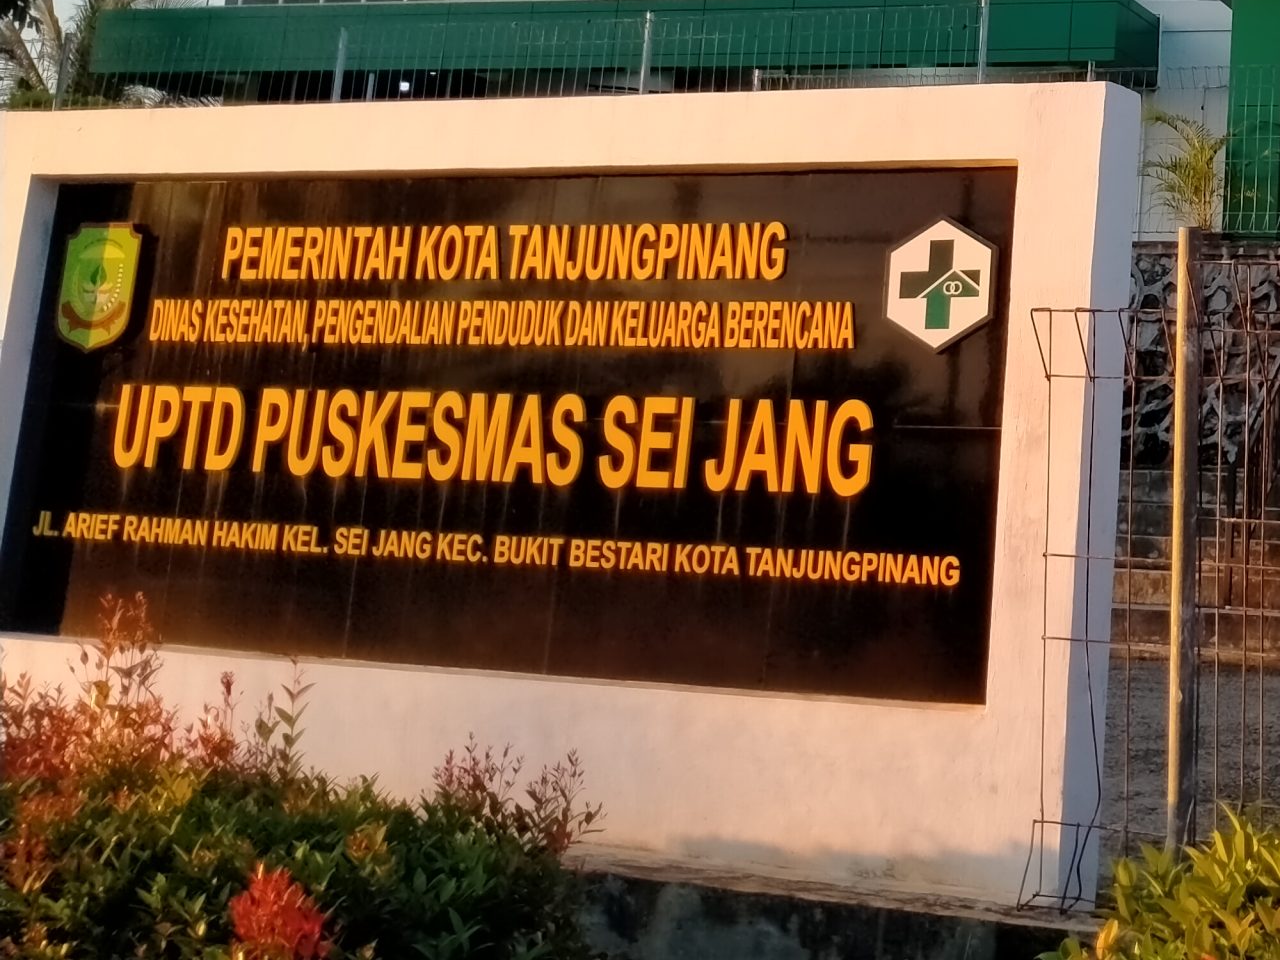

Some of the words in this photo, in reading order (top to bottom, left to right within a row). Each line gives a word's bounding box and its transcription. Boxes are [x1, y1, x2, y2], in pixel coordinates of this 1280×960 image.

[220, 224, 411, 281] PEMERINTAH
[416, 223, 499, 281] KOTA
[508, 220, 789, 281] TANJUNGPINANG
[149, 298, 204, 342] DINAS
[204, 299, 310, 352] KESEHATAN,
[311, 299, 456, 346] PENGENDALIAN
[457, 300, 562, 347] PENDUDUK
[564, 300, 611, 348] DAN
[610, 300, 722, 349] KELUARGA
[724, 300, 856, 350] BERENCANA
[112, 383, 246, 472] UPTD
[251, 387, 585, 488] PUSKESMAS
[598, 395, 697, 490] SEI
[704, 397, 875, 498] JANG
[32, 510, 59, 538] JL.
[61, 512, 121, 542] ARIEF
[122, 514, 208, 548] RAHMAN
[212, 520, 278, 552] HAKIM
[281, 523, 329, 555] KEL.
[333, 526, 370, 558] SEI
[371, 529, 432, 560] JANG
[435, 531, 489, 564] KEC.
[493, 534, 565, 568] BUKIT
[568, 538, 669, 573] BESTARI
[673, 543, 740, 576] KOTA
[745, 546, 962, 588] TANJUNGPINANG
